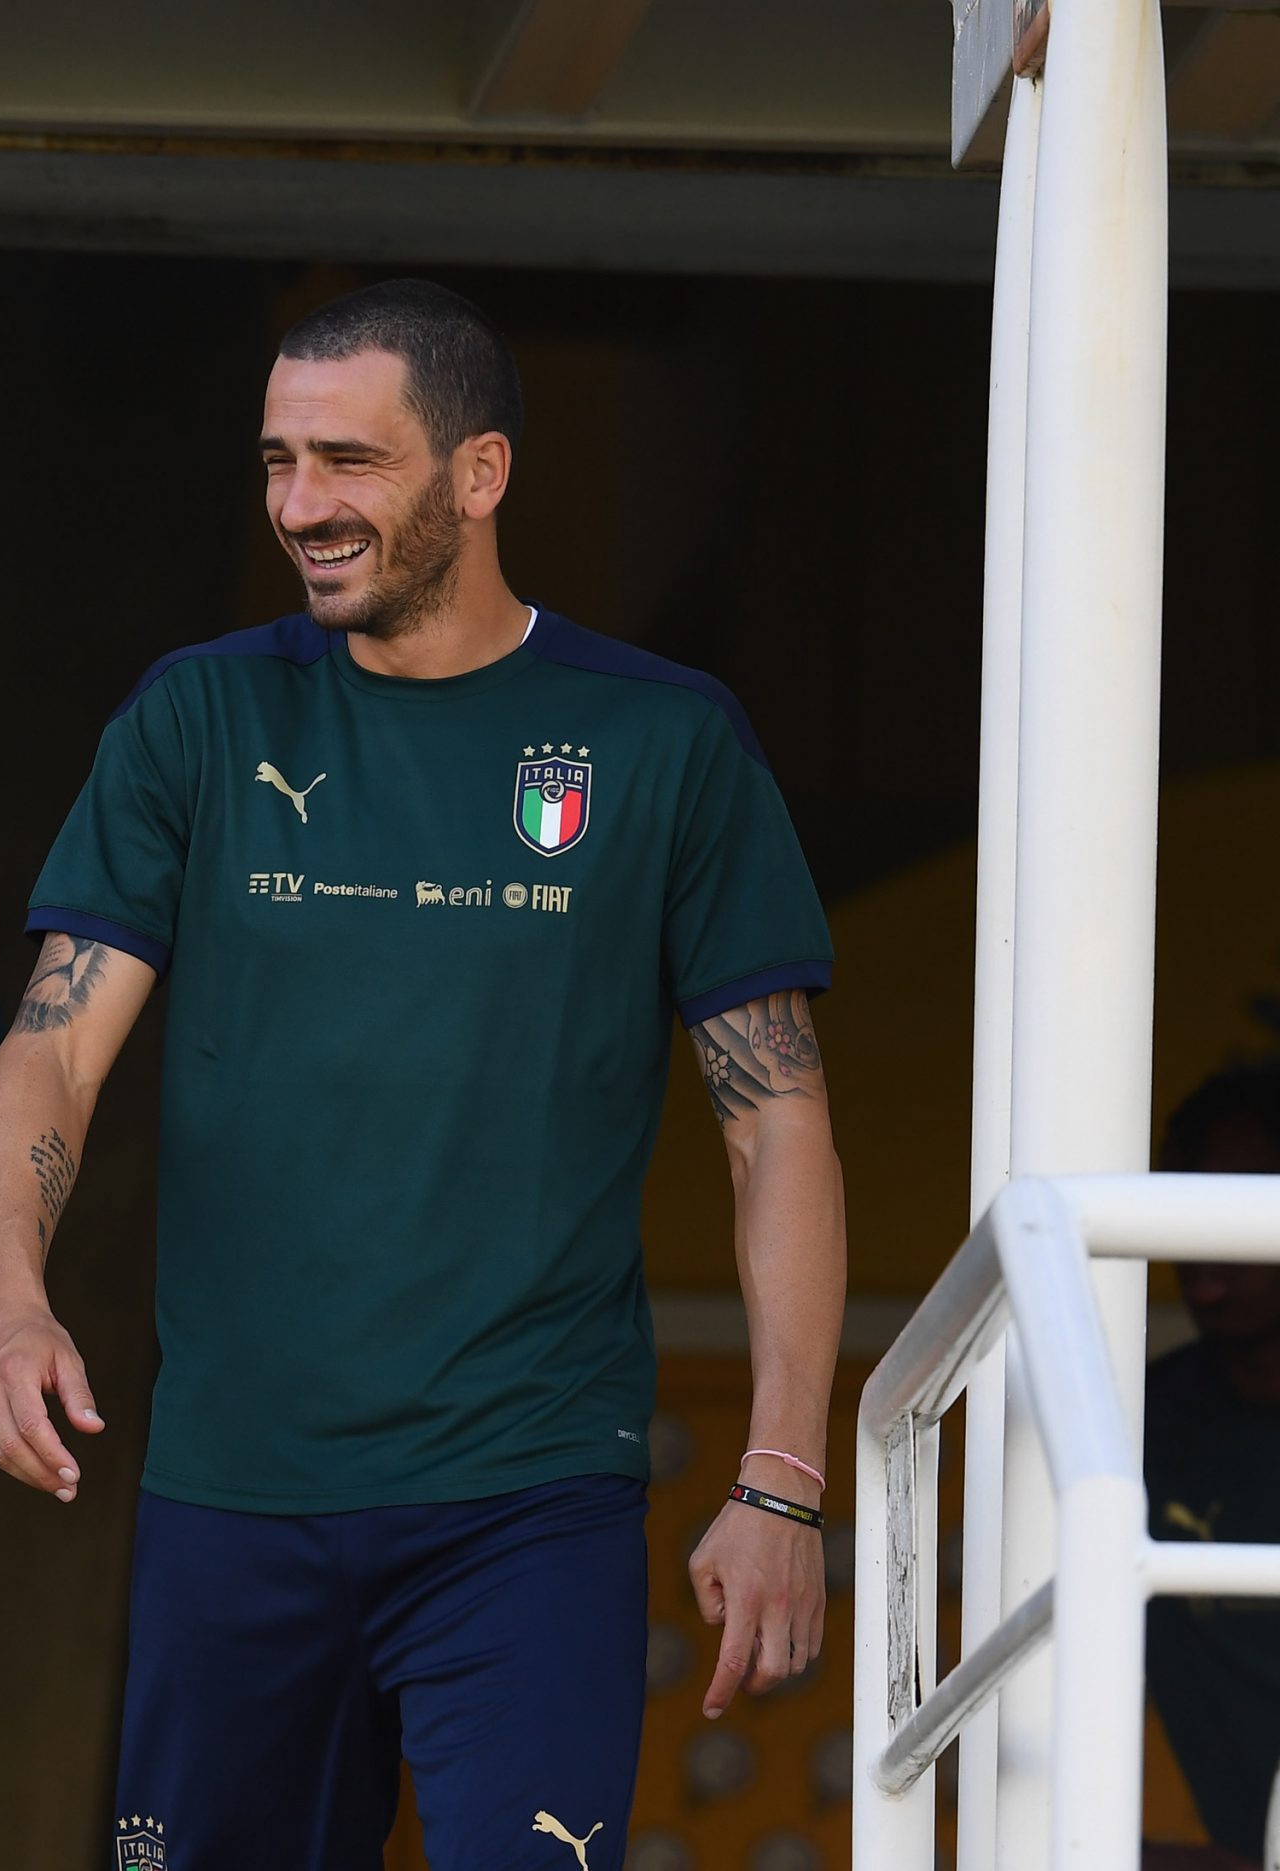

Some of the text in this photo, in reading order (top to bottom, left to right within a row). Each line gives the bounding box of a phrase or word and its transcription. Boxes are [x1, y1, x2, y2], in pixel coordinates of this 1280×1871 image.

[524, 767, 584, 784] ITALIA
[313, 882, 399, 899] Posteitaliane
[449, 879, 492, 907] eni
[509, 890, 523, 901] FIAT
[531, 884, 573, 913] FIAT
[123, 1842, 164, 1862] ITALIA
